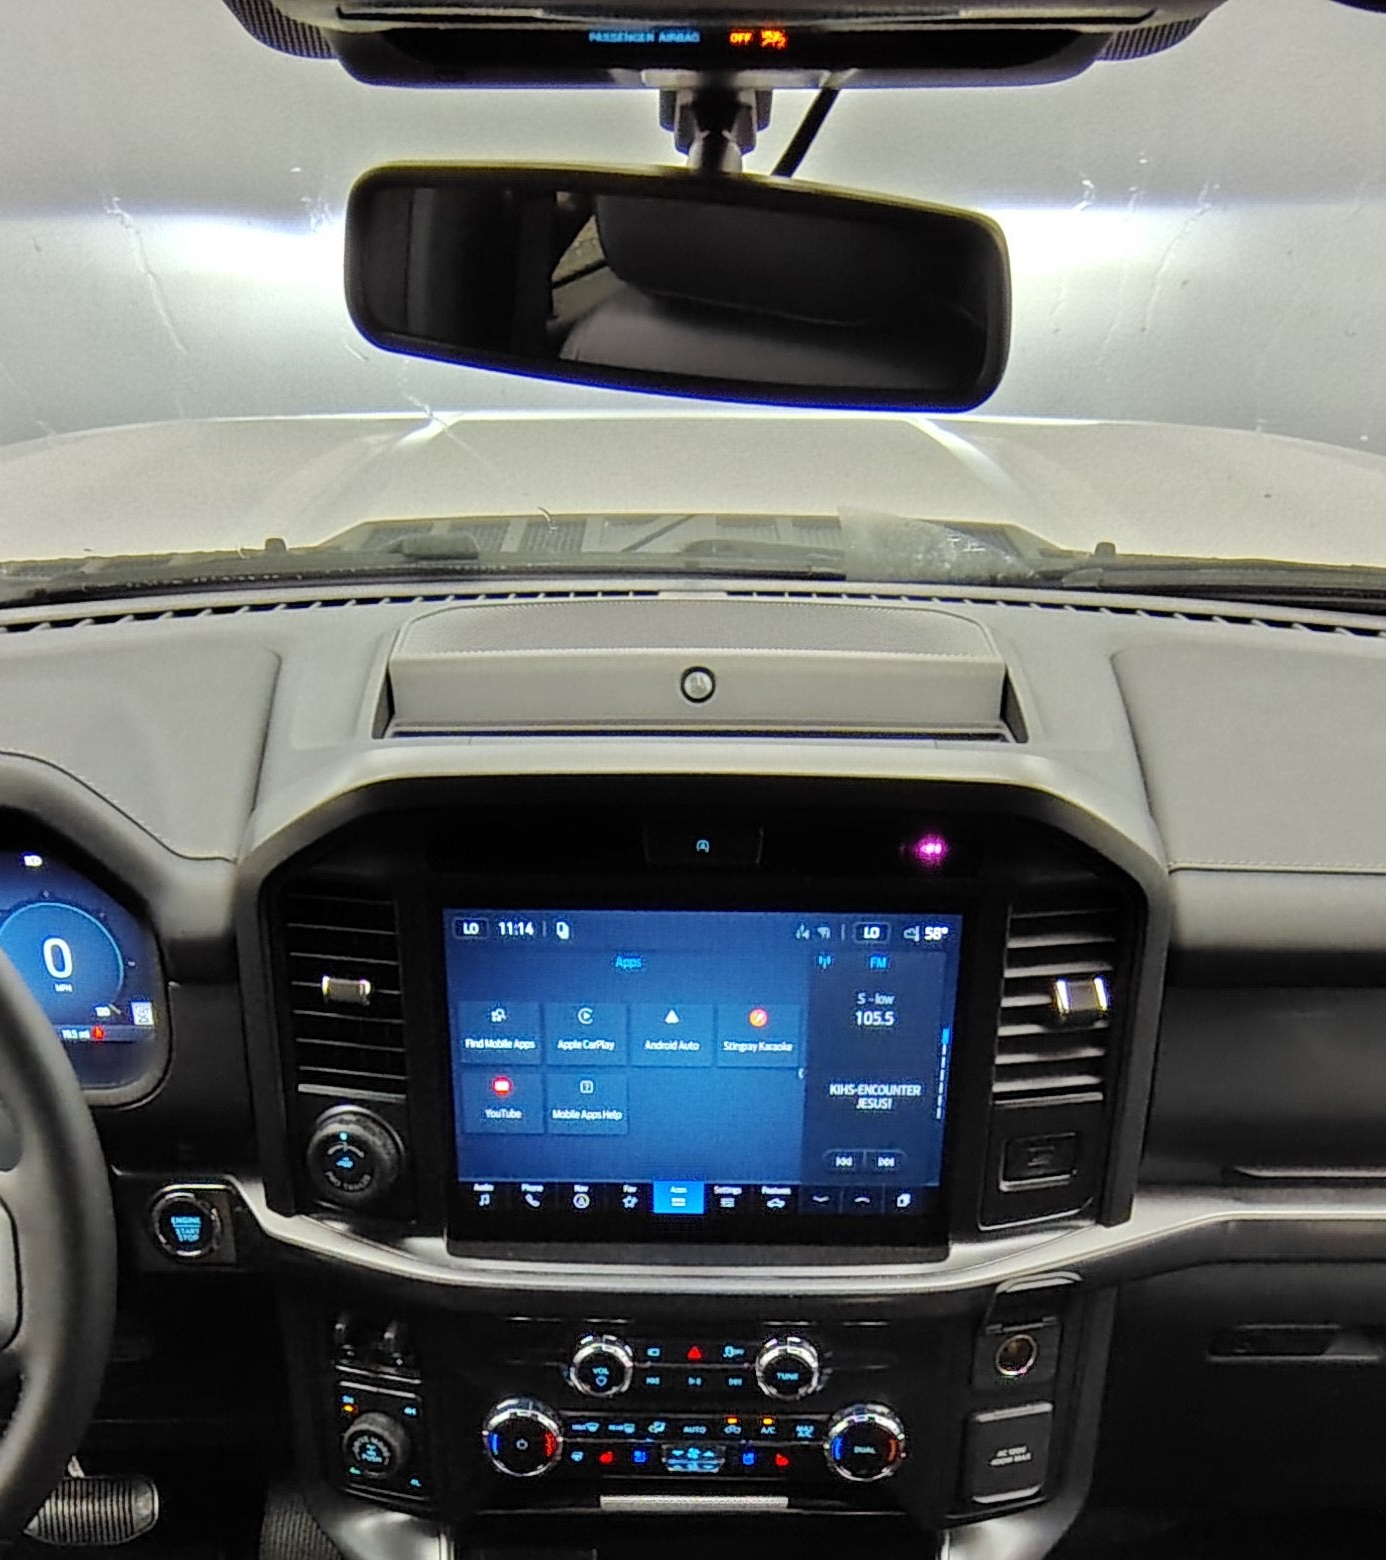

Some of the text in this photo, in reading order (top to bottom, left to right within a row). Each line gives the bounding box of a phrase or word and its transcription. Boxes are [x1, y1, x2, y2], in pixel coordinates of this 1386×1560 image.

[589, 31, 700, 43] PASSENGER AIRBAG
[730, 32, 752, 43] OFF
[463, 921, 534, 936] LO 11:14
[864, 926, 881, 939] LO
[43, 937, 73, 979] 0
[615, 956, 642, 970] Apps
[870, 956, 887, 970] FM
[855, 1011, 895, 1026] 105.5
[465, 1038, 536, 1052] Find Mobile Apps
[557, 1039, 615, 1052] Apple CarPlay
[644, 1040, 700, 1051] Android Auto
[723, 1040, 793, 1053] Stingray Karaoke
[829, 1083, 922, 1098] KIHS-ENCOUNTER
[485, 1109, 522, 1120] YouTube
[552, 1109, 623, 1121] Mobile Apps Help
[521, 1183, 544, 1192] Phone
[713, 1185, 742, 1195] Settings
[171, 1216, 201, 1224] ENGINE
[593, 1367, 610, 1375] VOL
[776, 1372, 799, 1380] TUNE
[683, 1425, 707, 1434] AUTO
[760, 1426, 776, 1435] A/C
[853, 1445, 877, 1454] DUAL
